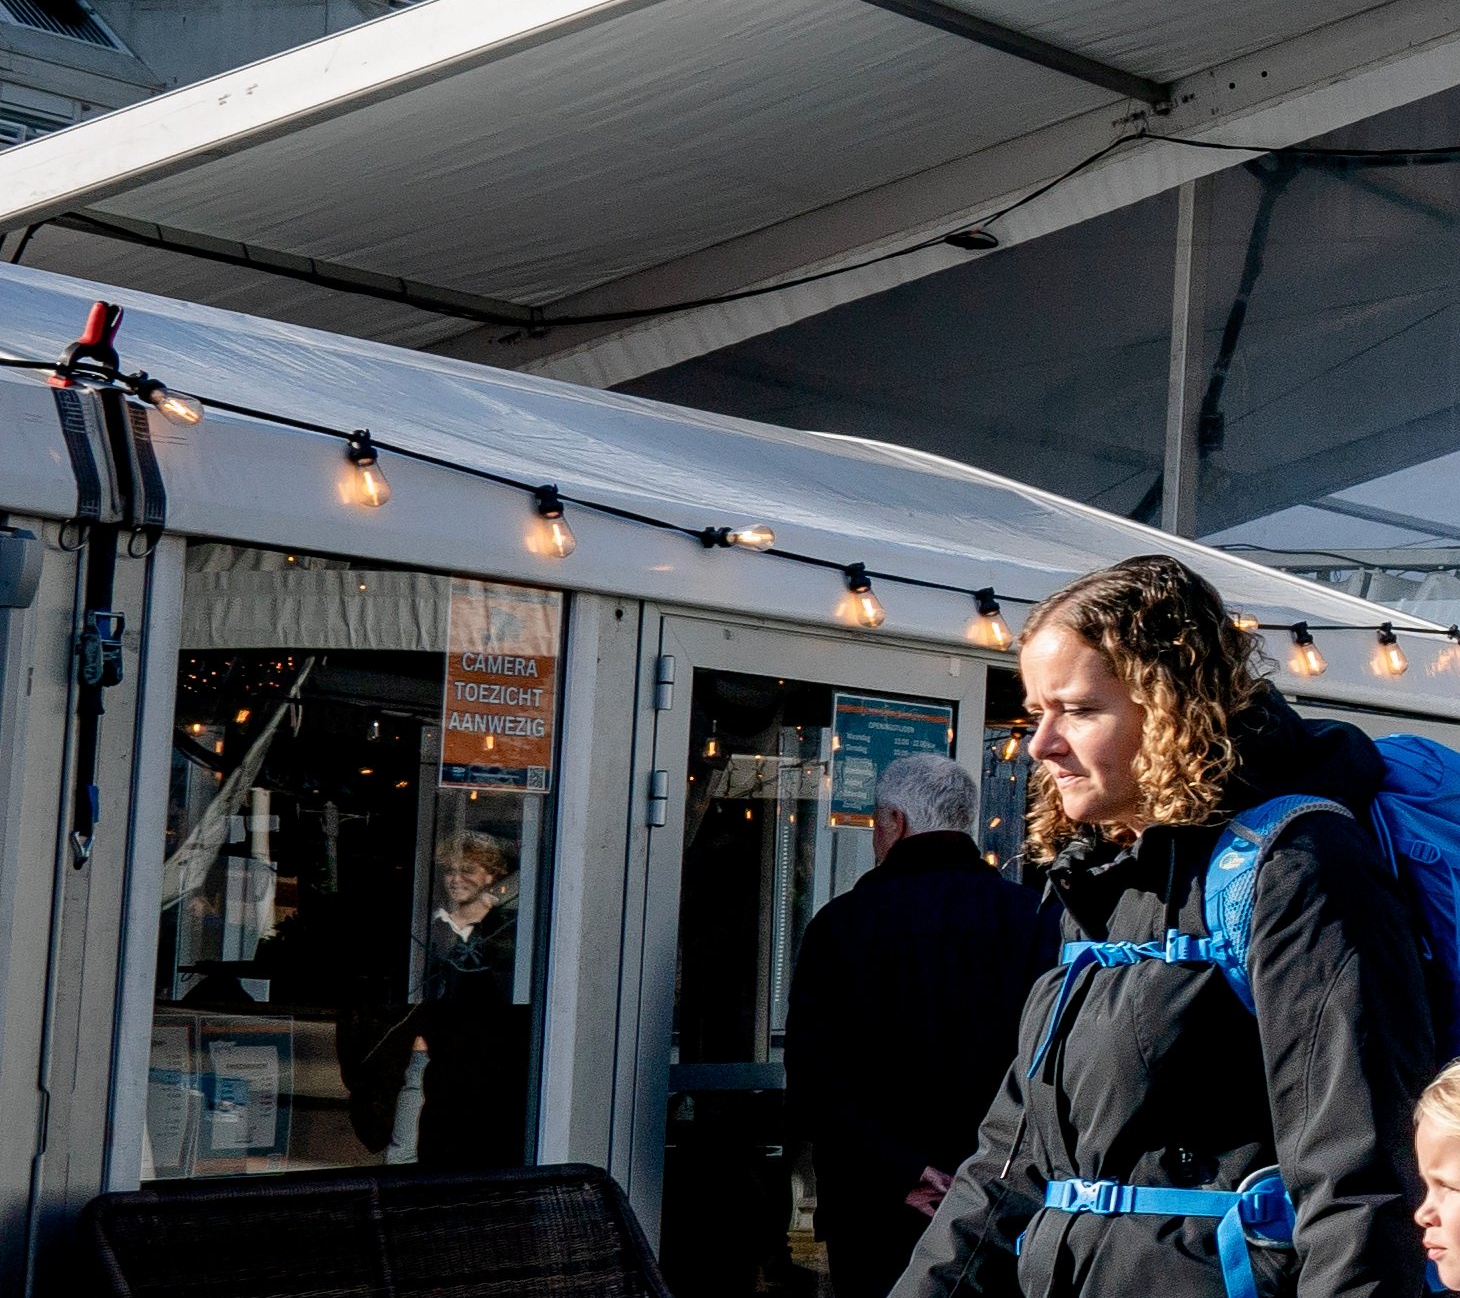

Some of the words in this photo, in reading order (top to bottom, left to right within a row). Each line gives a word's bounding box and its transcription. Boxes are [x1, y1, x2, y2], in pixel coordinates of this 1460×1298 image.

[462, 652, 538, 678] CAMERA
[454, 681, 545, 707] TOEZICHT
[448, 712, 545, 737] AANWEZIG
